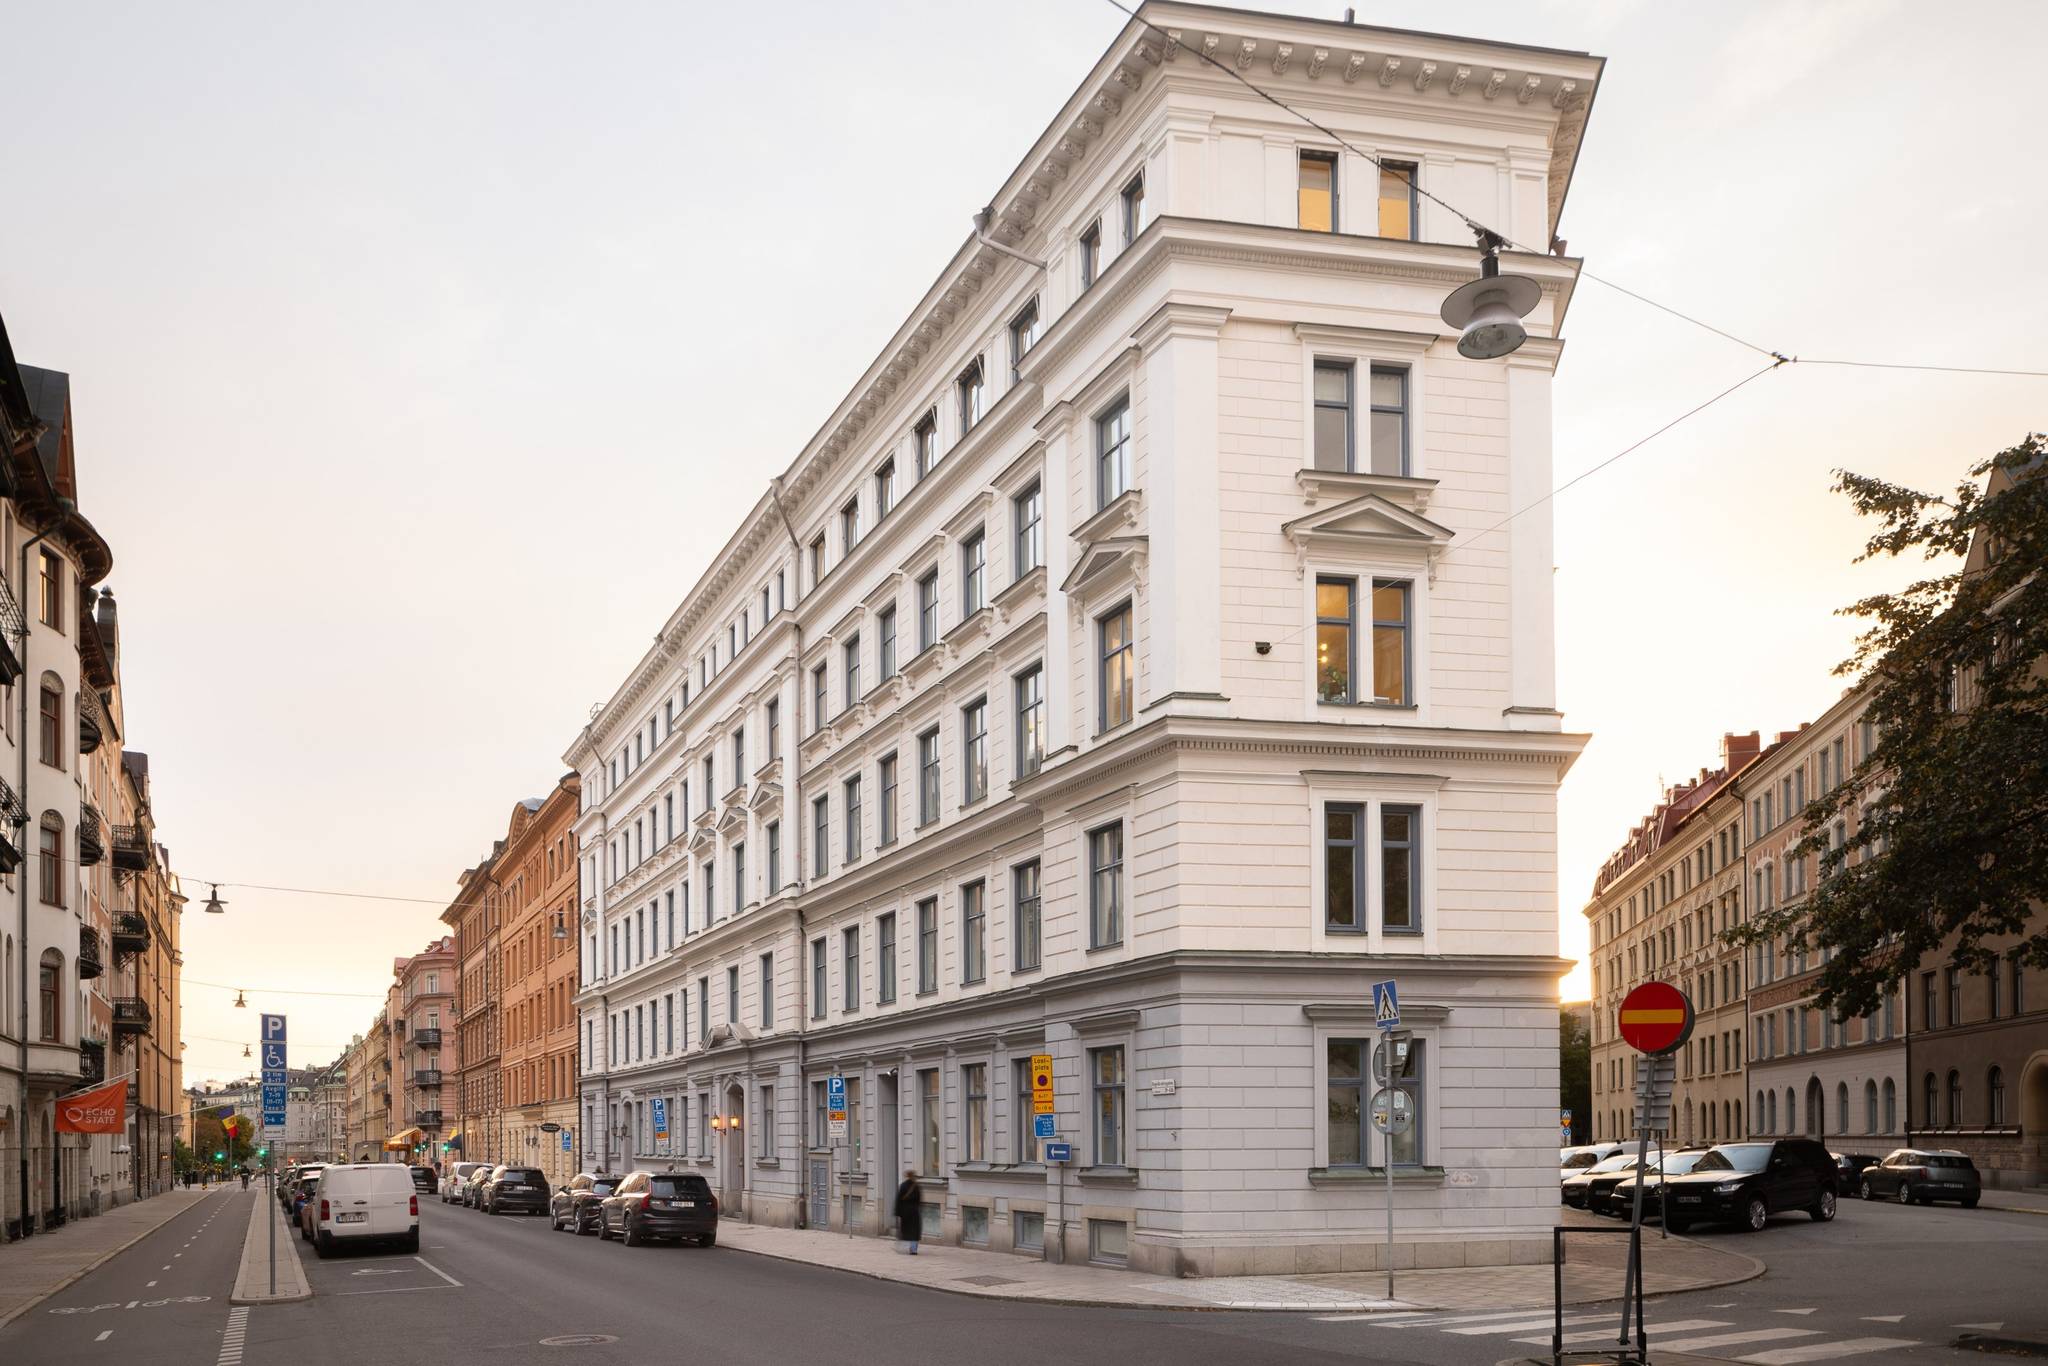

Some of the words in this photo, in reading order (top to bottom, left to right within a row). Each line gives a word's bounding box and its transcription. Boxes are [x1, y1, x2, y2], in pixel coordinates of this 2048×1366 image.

[268, 1016, 283, 1039] P
[832, 1079, 842, 1093] P
[654, 1099, 662, 1110] P
[86, 1108, 117, 1116] ECHO
[86, 1116, 116, 1125] STATE
[563, 1132, 570, 1141] P
